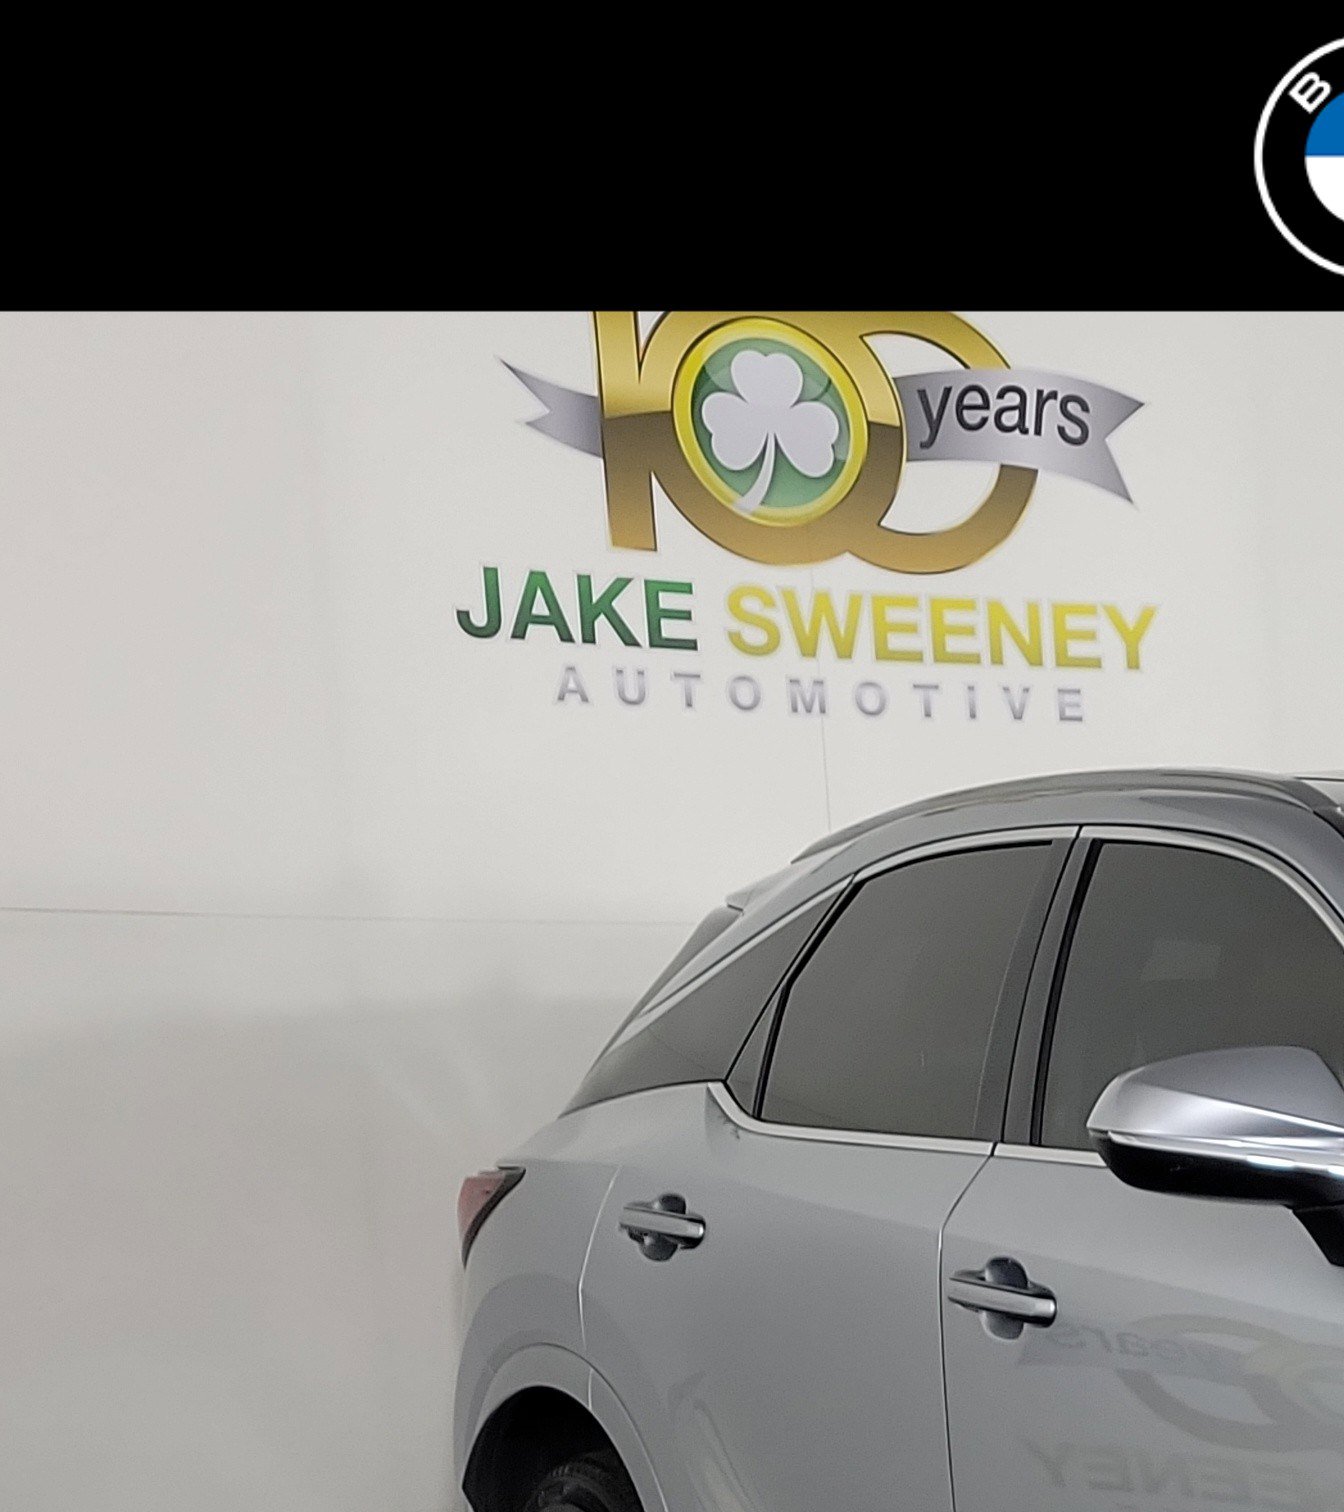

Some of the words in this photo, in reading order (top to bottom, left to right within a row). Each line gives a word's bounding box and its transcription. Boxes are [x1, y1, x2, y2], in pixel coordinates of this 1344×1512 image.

[916, 382, 1091, 447] years
[455, 565, 698, 652] JAKE
[726, 583, 1159, 671] SWEENEY
[555, 664, 1085, 723] AUTOMOTIVE
